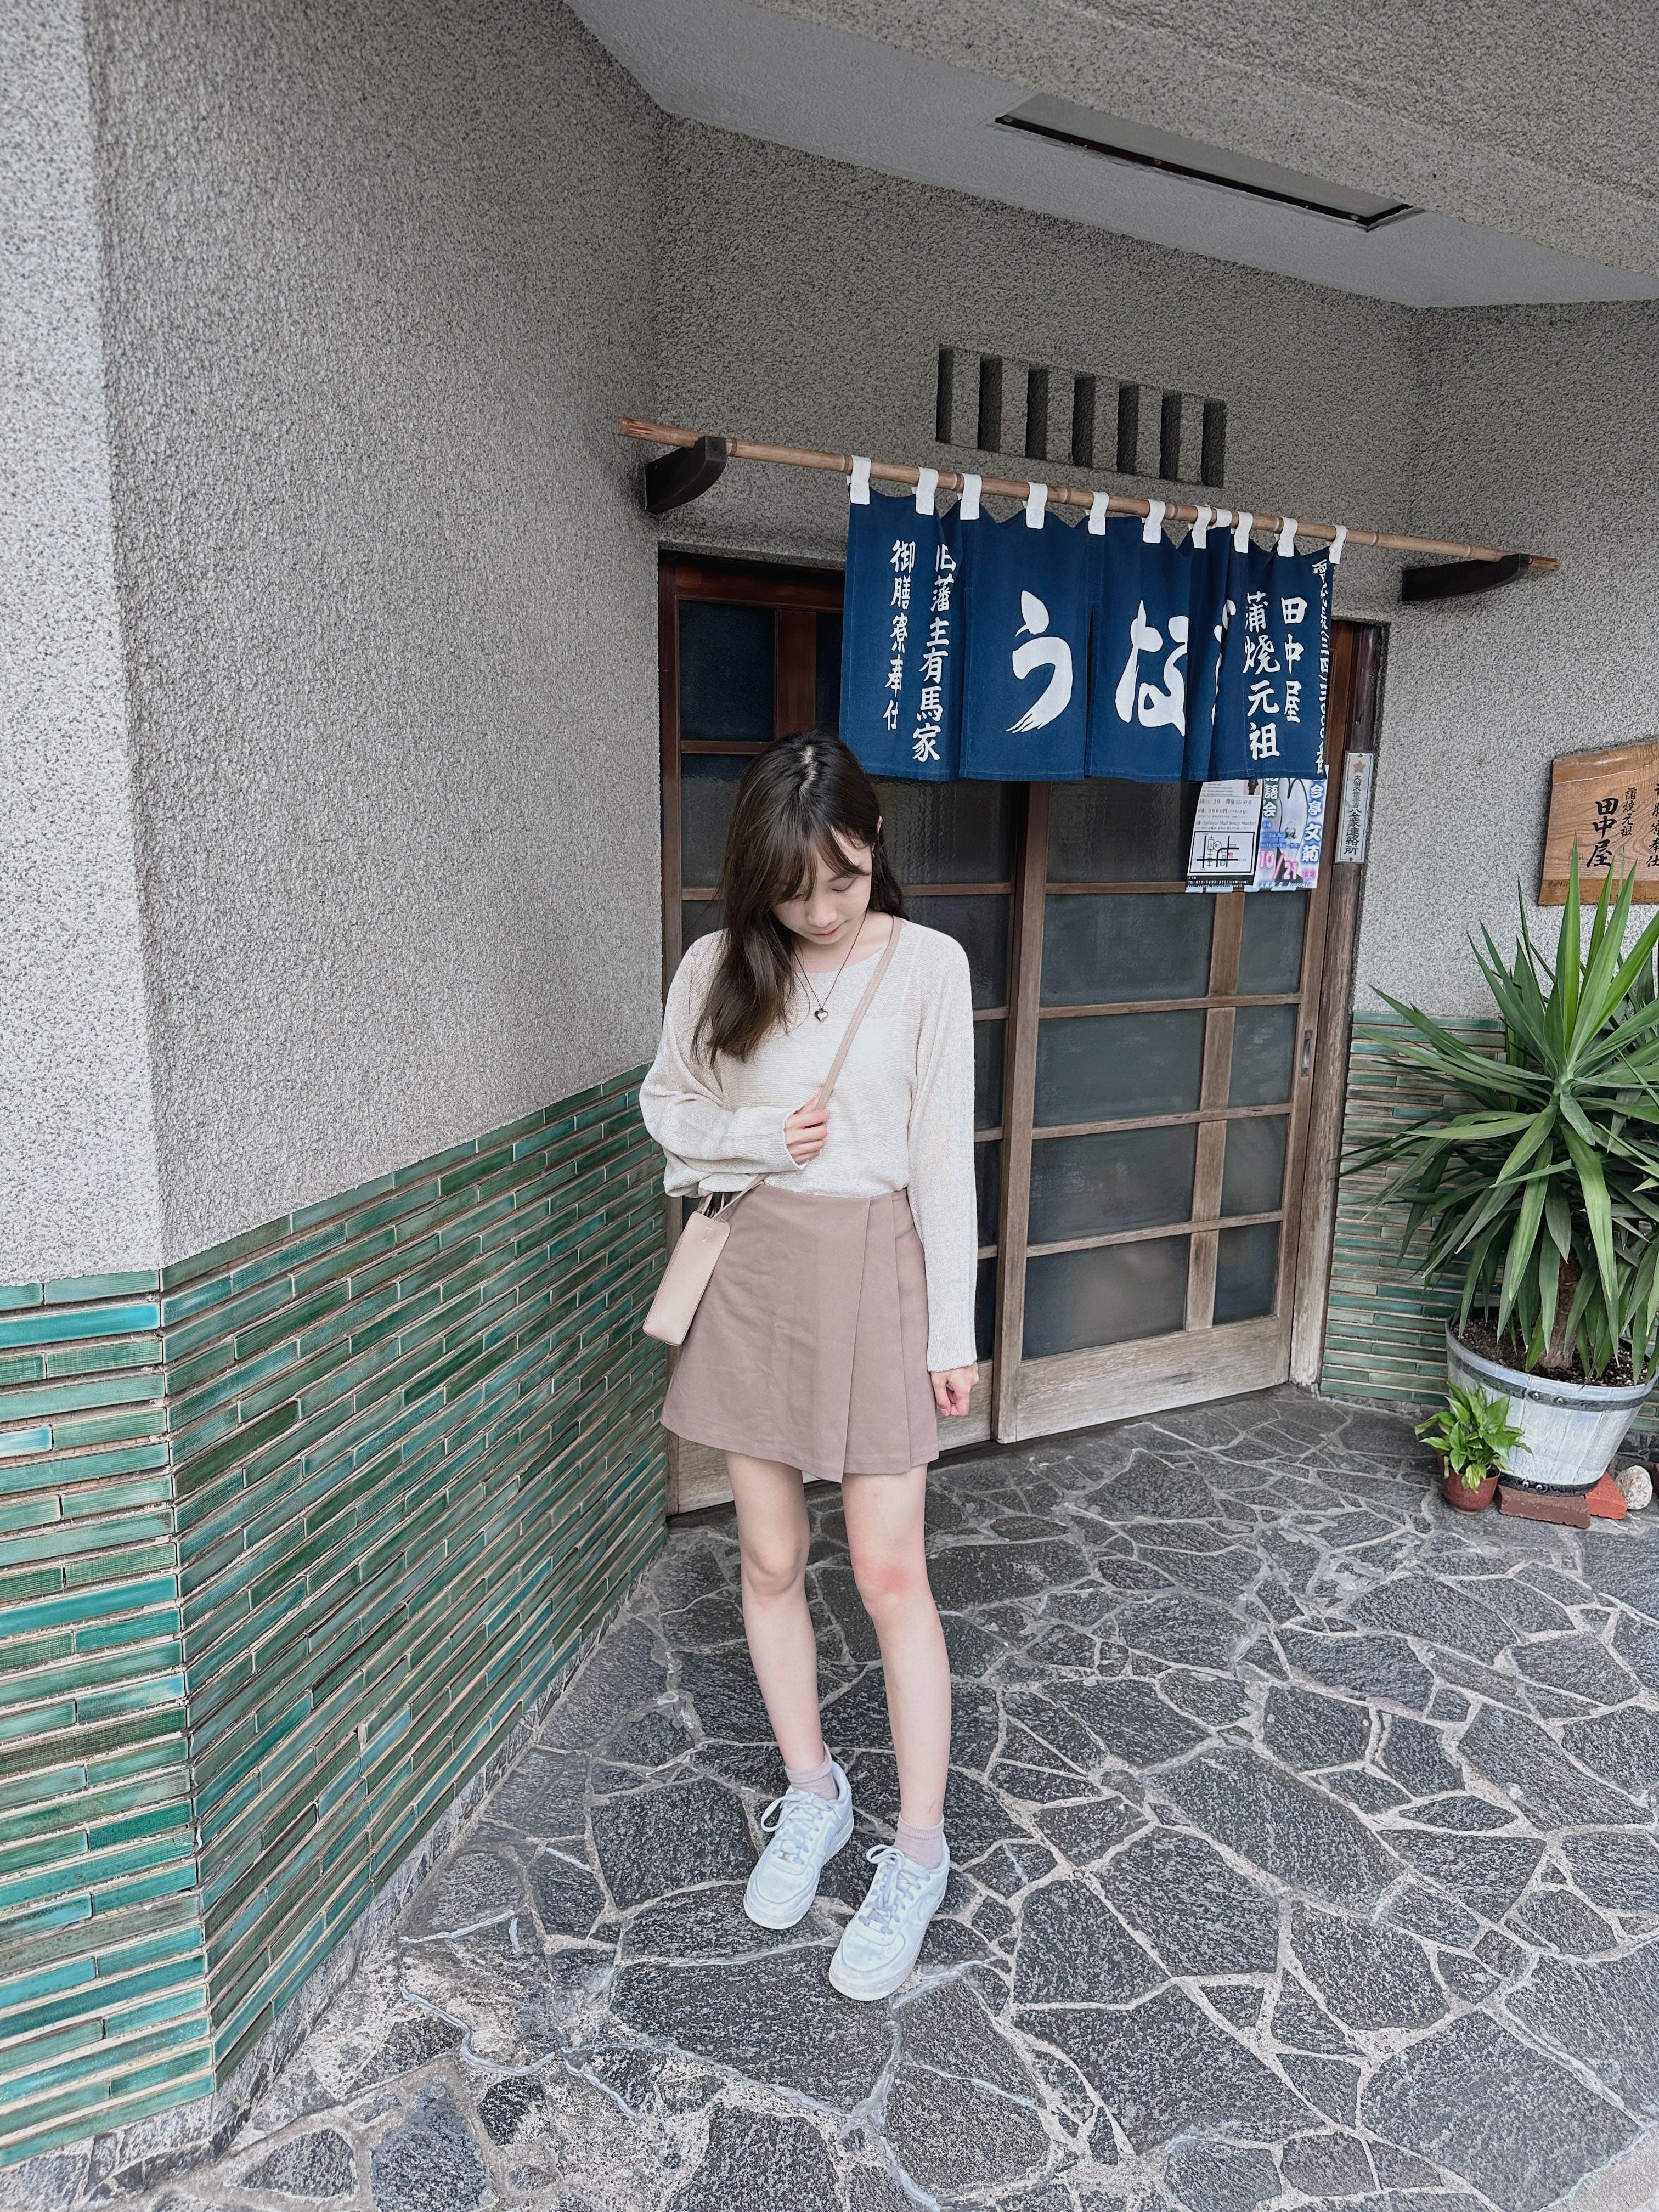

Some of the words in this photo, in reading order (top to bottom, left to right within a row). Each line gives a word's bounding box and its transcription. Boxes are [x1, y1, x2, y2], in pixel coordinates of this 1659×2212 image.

[883, 540, 915, 731] 御膳寮奉仕
[912, 544, 956, 763] 旧藩主有馬家
[1006, 590, 1236, 737] うな
[1242, 591, 1281, 760] 蒲焼元祖
[1281, 597, 1308, 723] 田中屋
[1263, 778, 1279, 817] 語会
[1301, 823, 1321, 862] 文菊
[1308, 778, 1324, 816] 今亭
[1587, 798, 1618, 868] 田中屋
